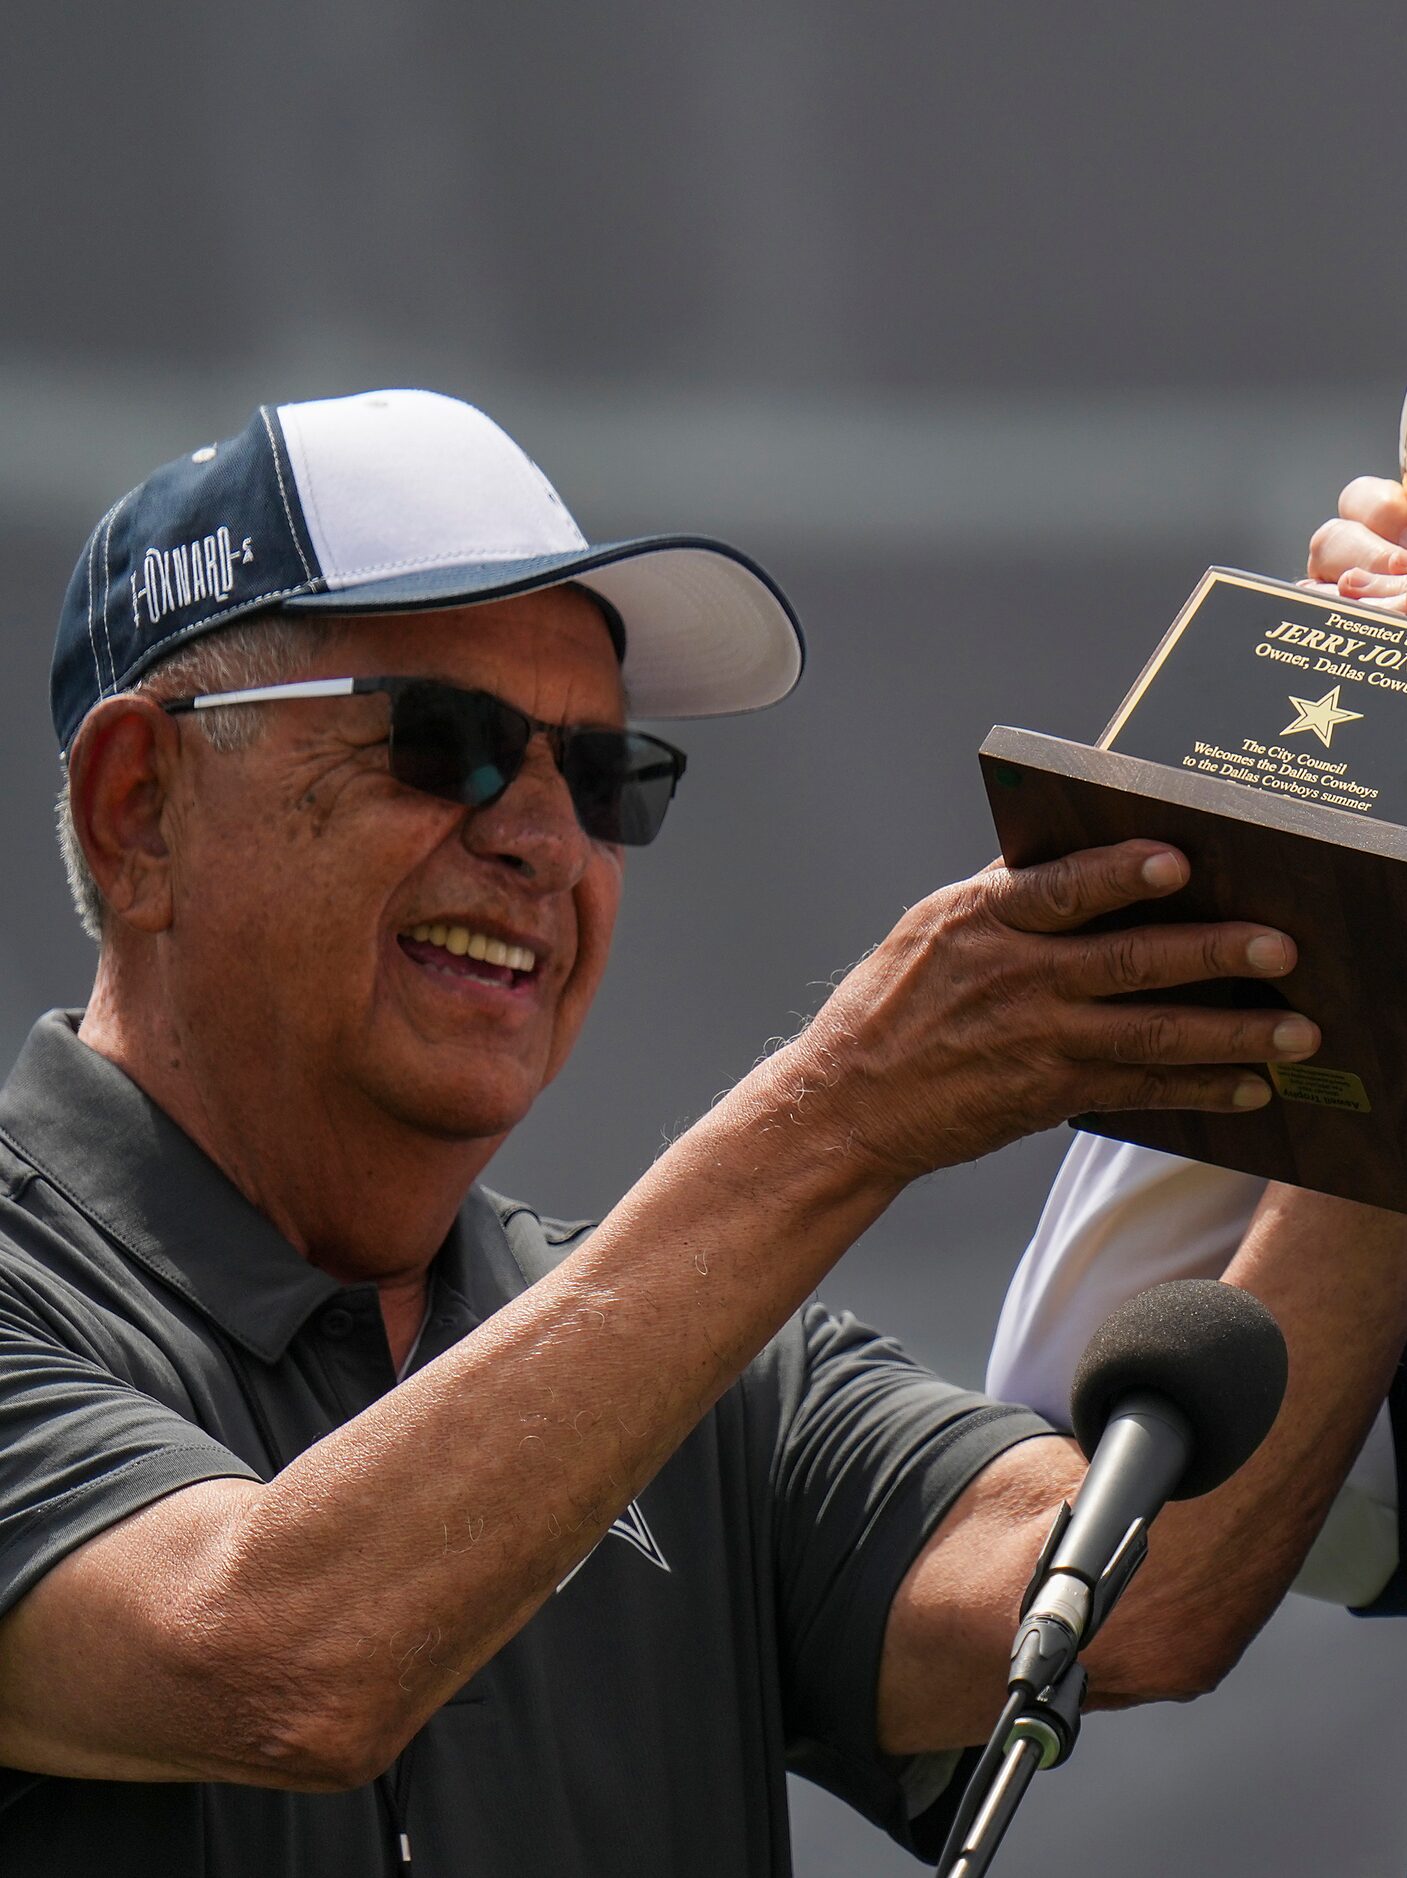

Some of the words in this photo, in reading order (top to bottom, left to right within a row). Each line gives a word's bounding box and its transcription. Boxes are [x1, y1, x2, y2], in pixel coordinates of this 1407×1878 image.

[141, 526, 238, 624] OXNARD
[1265, 621, 1364, 659] JERRY
[1325, 613, 1404, 643] Presented
[1256, 643, 1309, 669] Owner,
[1313, 658, 1365, 681] Dallas
[1195, 742, 1255, 766] Welcomes
[1257, 759, 1277, 772] the
[1279, 764, 1318, 783] Dallas
[1321, 775, 1378, 798] Cowboys
[1242, 739, 1266, 754] The
[1268, 747, 1295, 763] City
[1297, 754, 1347, 775] Council
[1183, 756, 1196, 766] to
[1198, 759, 1218, 772] the
[1219, 764, 1260, 782] Dallas
[1262, 775, 1319, 798] Cowboys
[1320, 793, 1372, 811] summer
